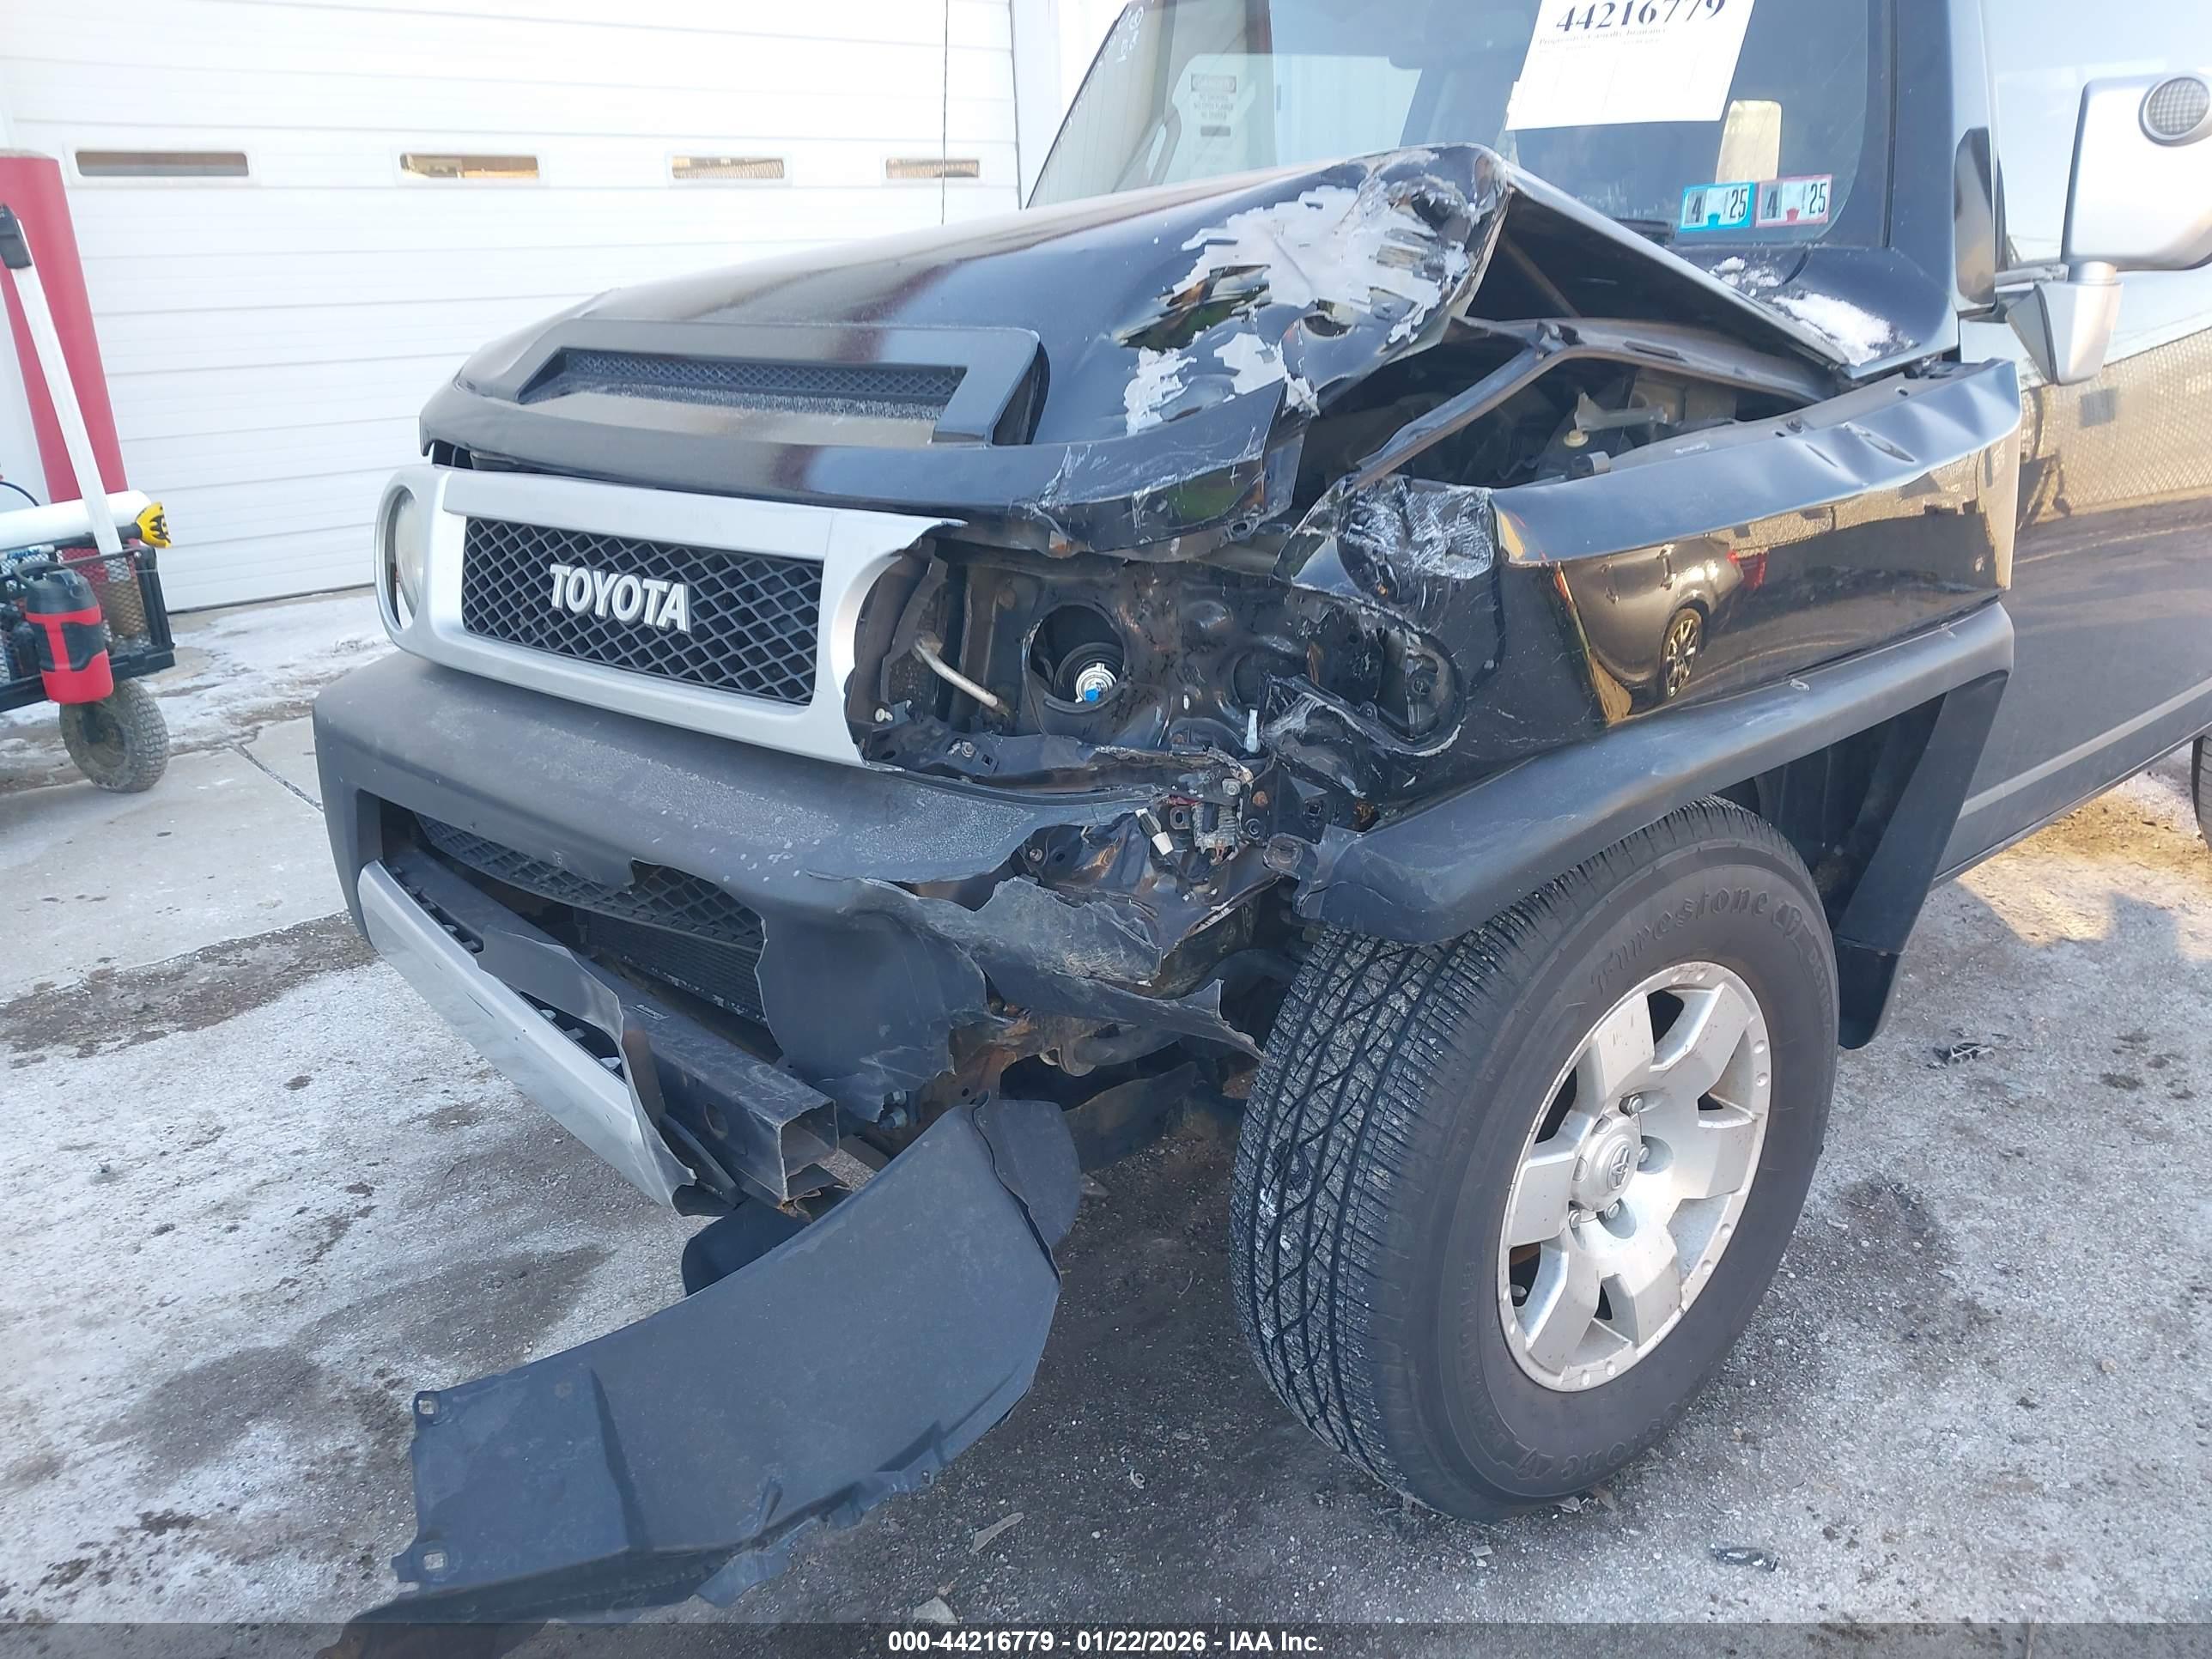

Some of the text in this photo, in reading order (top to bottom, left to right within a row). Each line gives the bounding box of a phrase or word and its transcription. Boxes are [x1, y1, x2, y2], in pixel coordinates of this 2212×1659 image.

[1555, 0, 1726, 32] 44216779
[1691, 188, 1748, 222] 4 25
[1766, 183, 1828, 218] 4 25
[549, 562, 692, 635] TOYOTA
